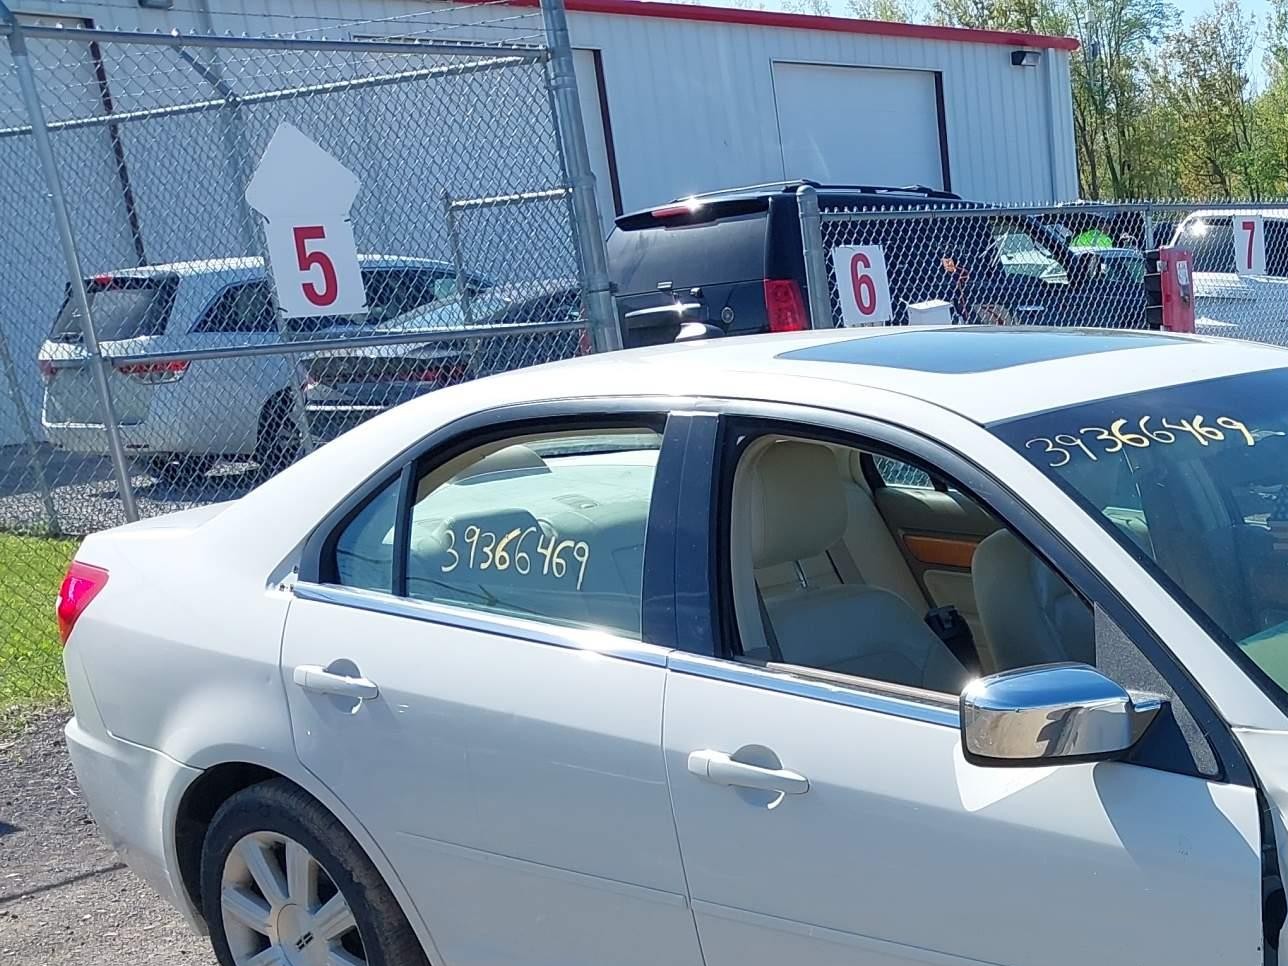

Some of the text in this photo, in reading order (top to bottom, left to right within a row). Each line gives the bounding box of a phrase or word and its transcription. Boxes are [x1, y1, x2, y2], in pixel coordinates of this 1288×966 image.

[292, 225, 339, 307] 5
[1242, 220, 1255, 270] 7
[850, 252, 877, 316] 6
[1025, 414, 1256, 468] 39366469
[440, 524, 589, 591] 39366469
